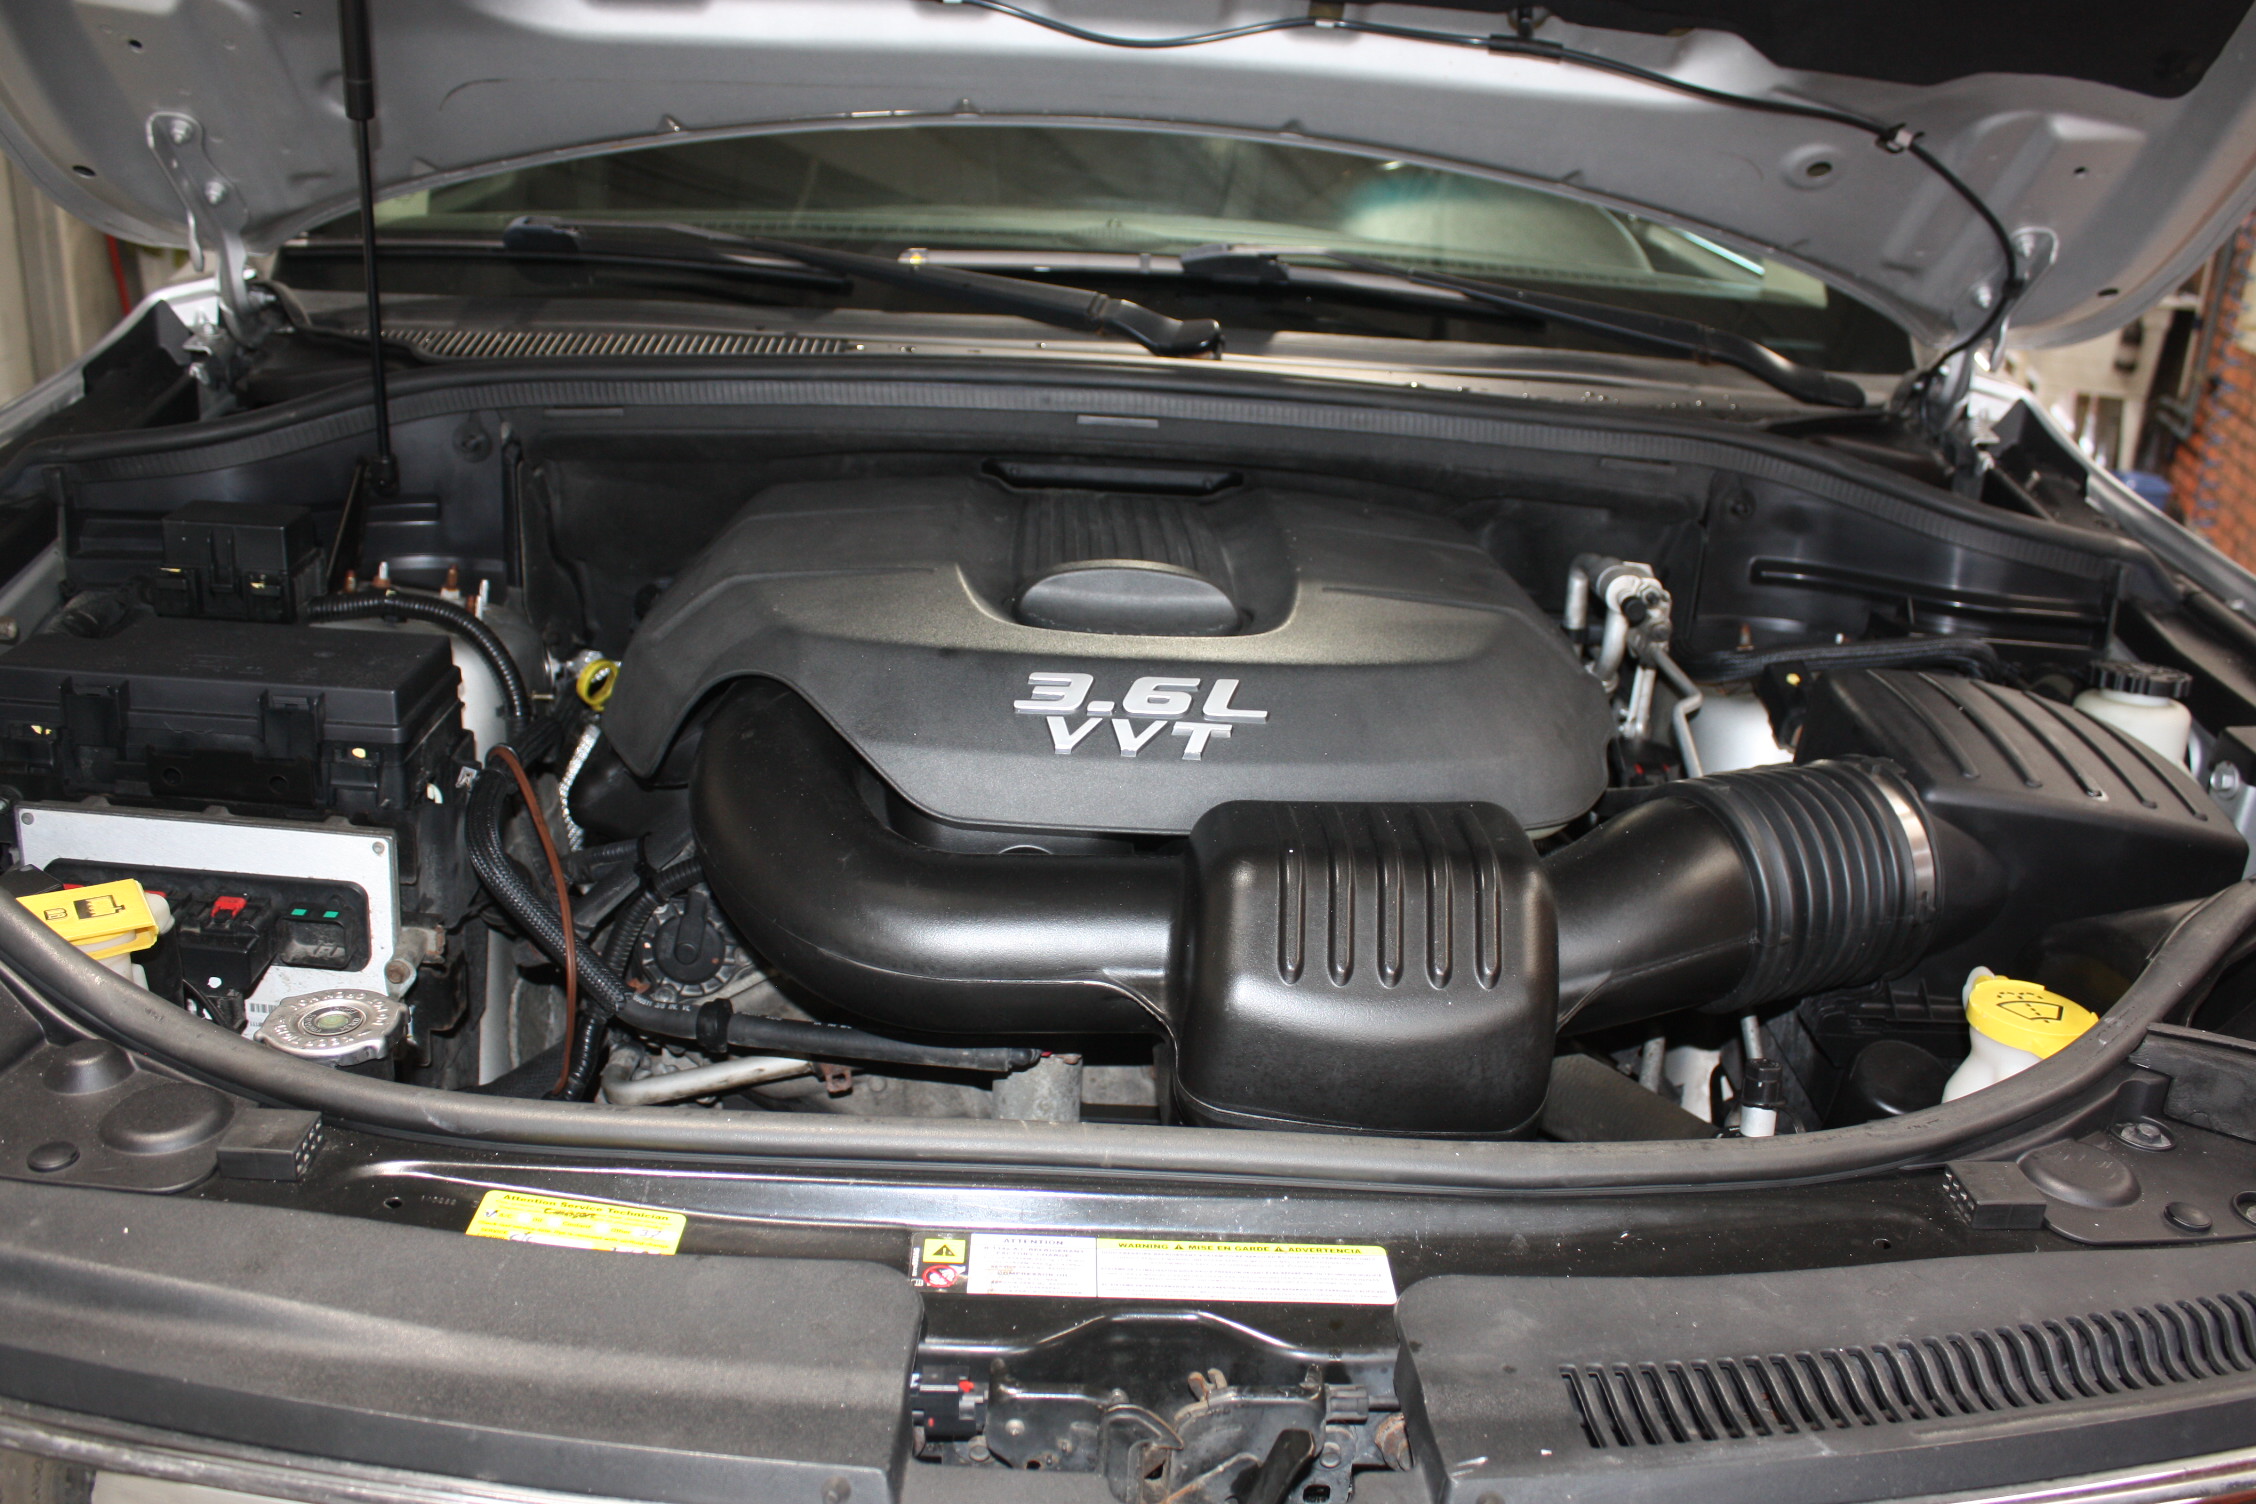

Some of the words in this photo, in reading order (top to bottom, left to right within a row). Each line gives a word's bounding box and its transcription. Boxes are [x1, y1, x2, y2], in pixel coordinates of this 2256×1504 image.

[1013, 671, 1268, 724] 3.6L
[1046, 716, 1233, 761] VVT
[503, 1194, 557, 1206] Attention
[560, 1201, 603, 1212] Service
[607, 1207, 670, 1221] Technician
